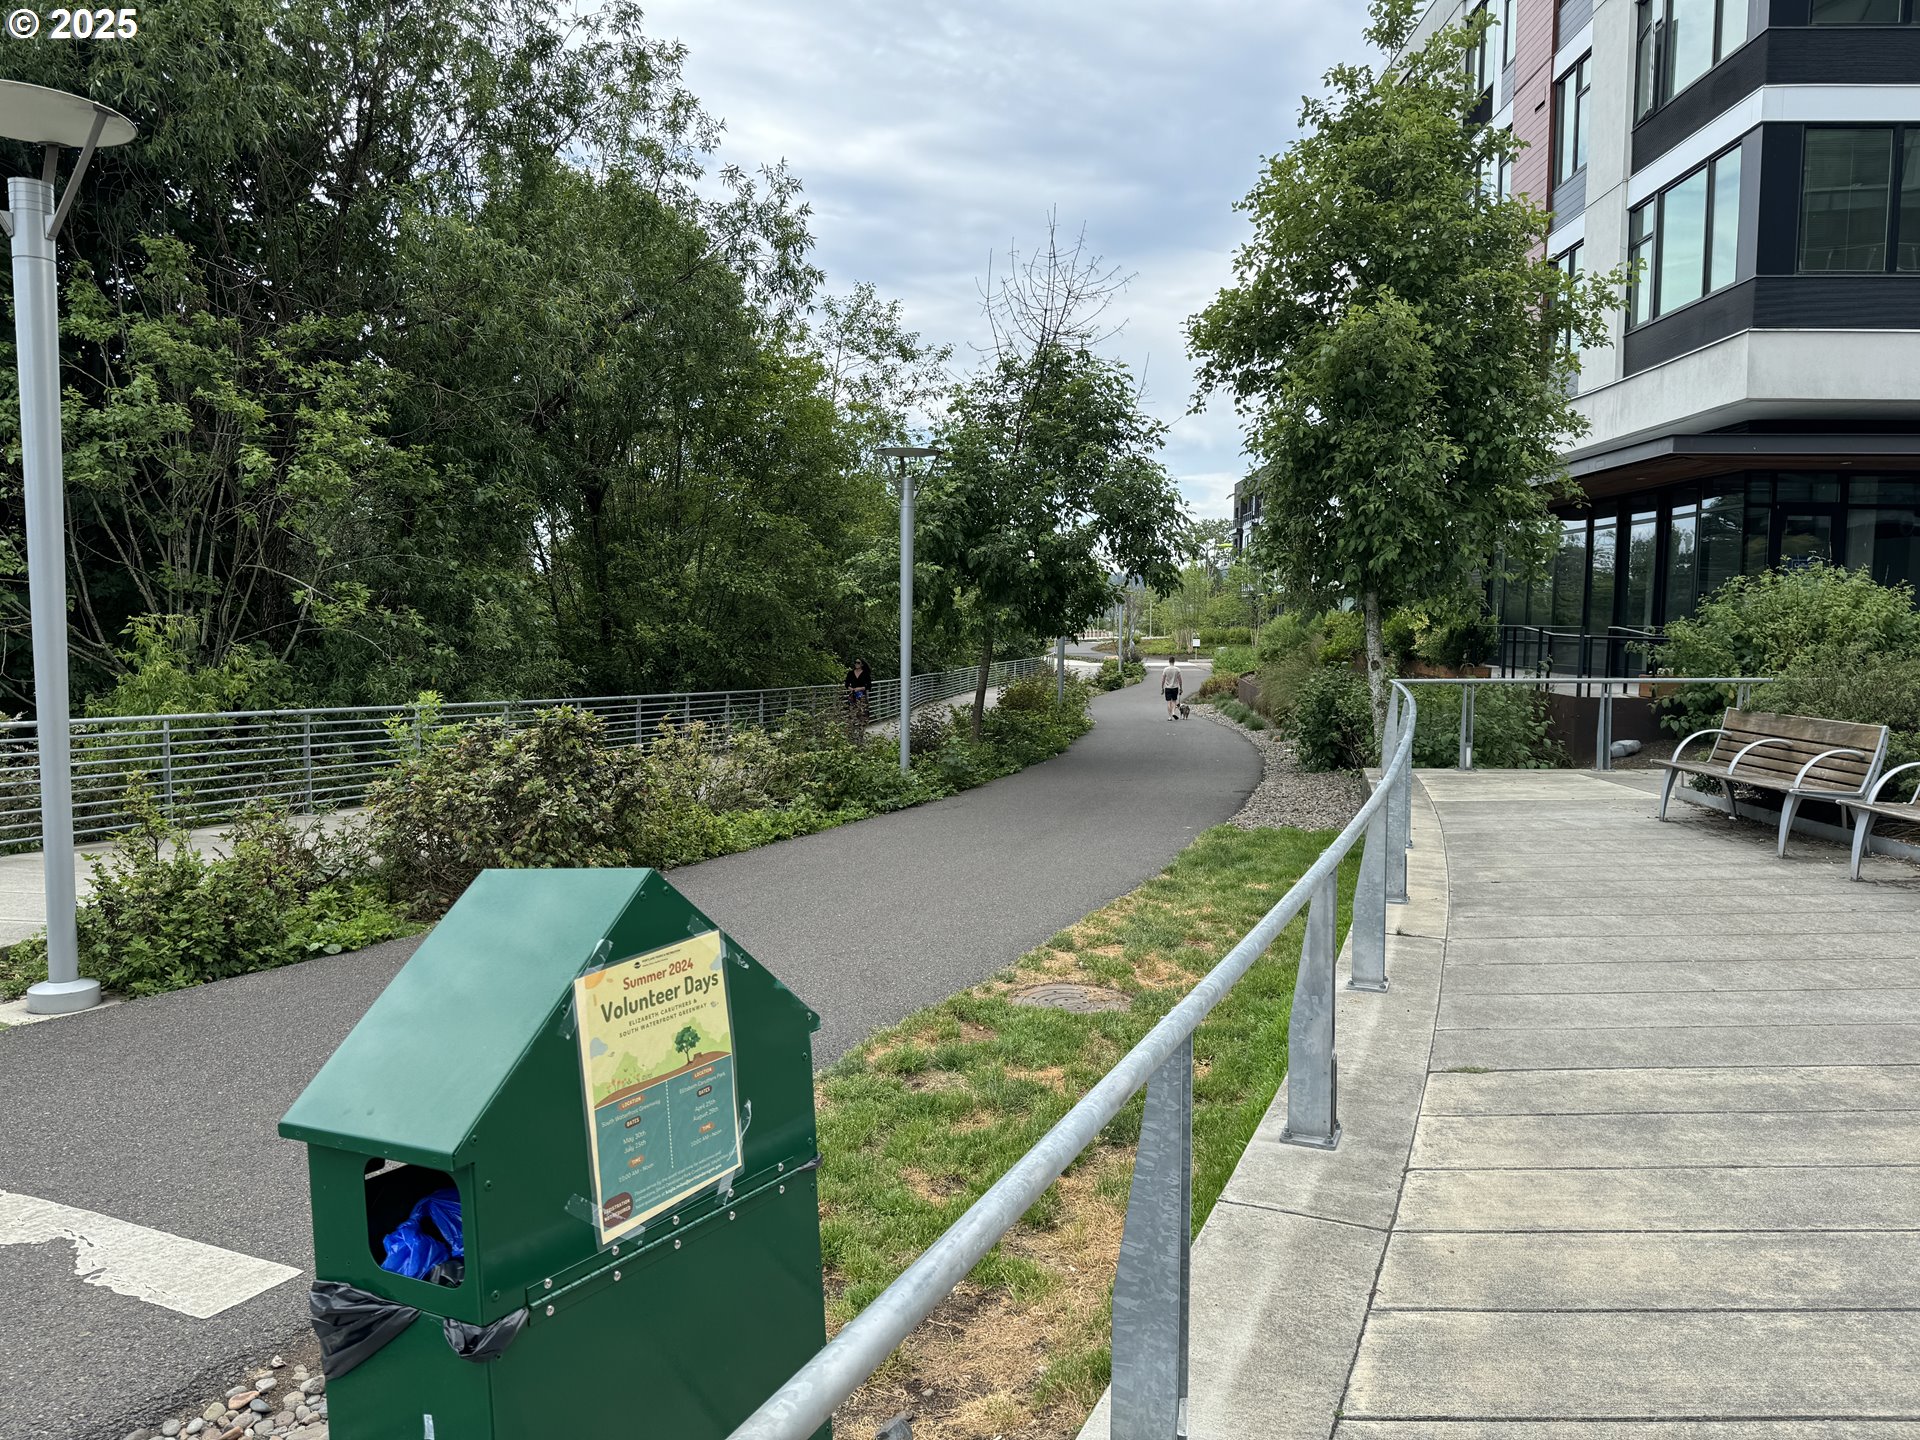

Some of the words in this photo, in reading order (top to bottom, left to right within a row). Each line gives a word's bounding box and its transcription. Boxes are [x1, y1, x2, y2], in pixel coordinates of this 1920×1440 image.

[623, 968, 667, 990] Summer
[669, 957, 694, 977] 2024
[600, 984, 681, 1023] Volunteer
[684, 973, 719, 995] Days
[628, 1012, 659, 1027] ELIZABETH
[660, 1001, 693, 1016] CARUTHERS
[619, 1026, 639, 1039] SOUTH
[640, 1013, 678, 1031] WATERFRONT
[678, 1002, 708, 1017] GREENWAY
